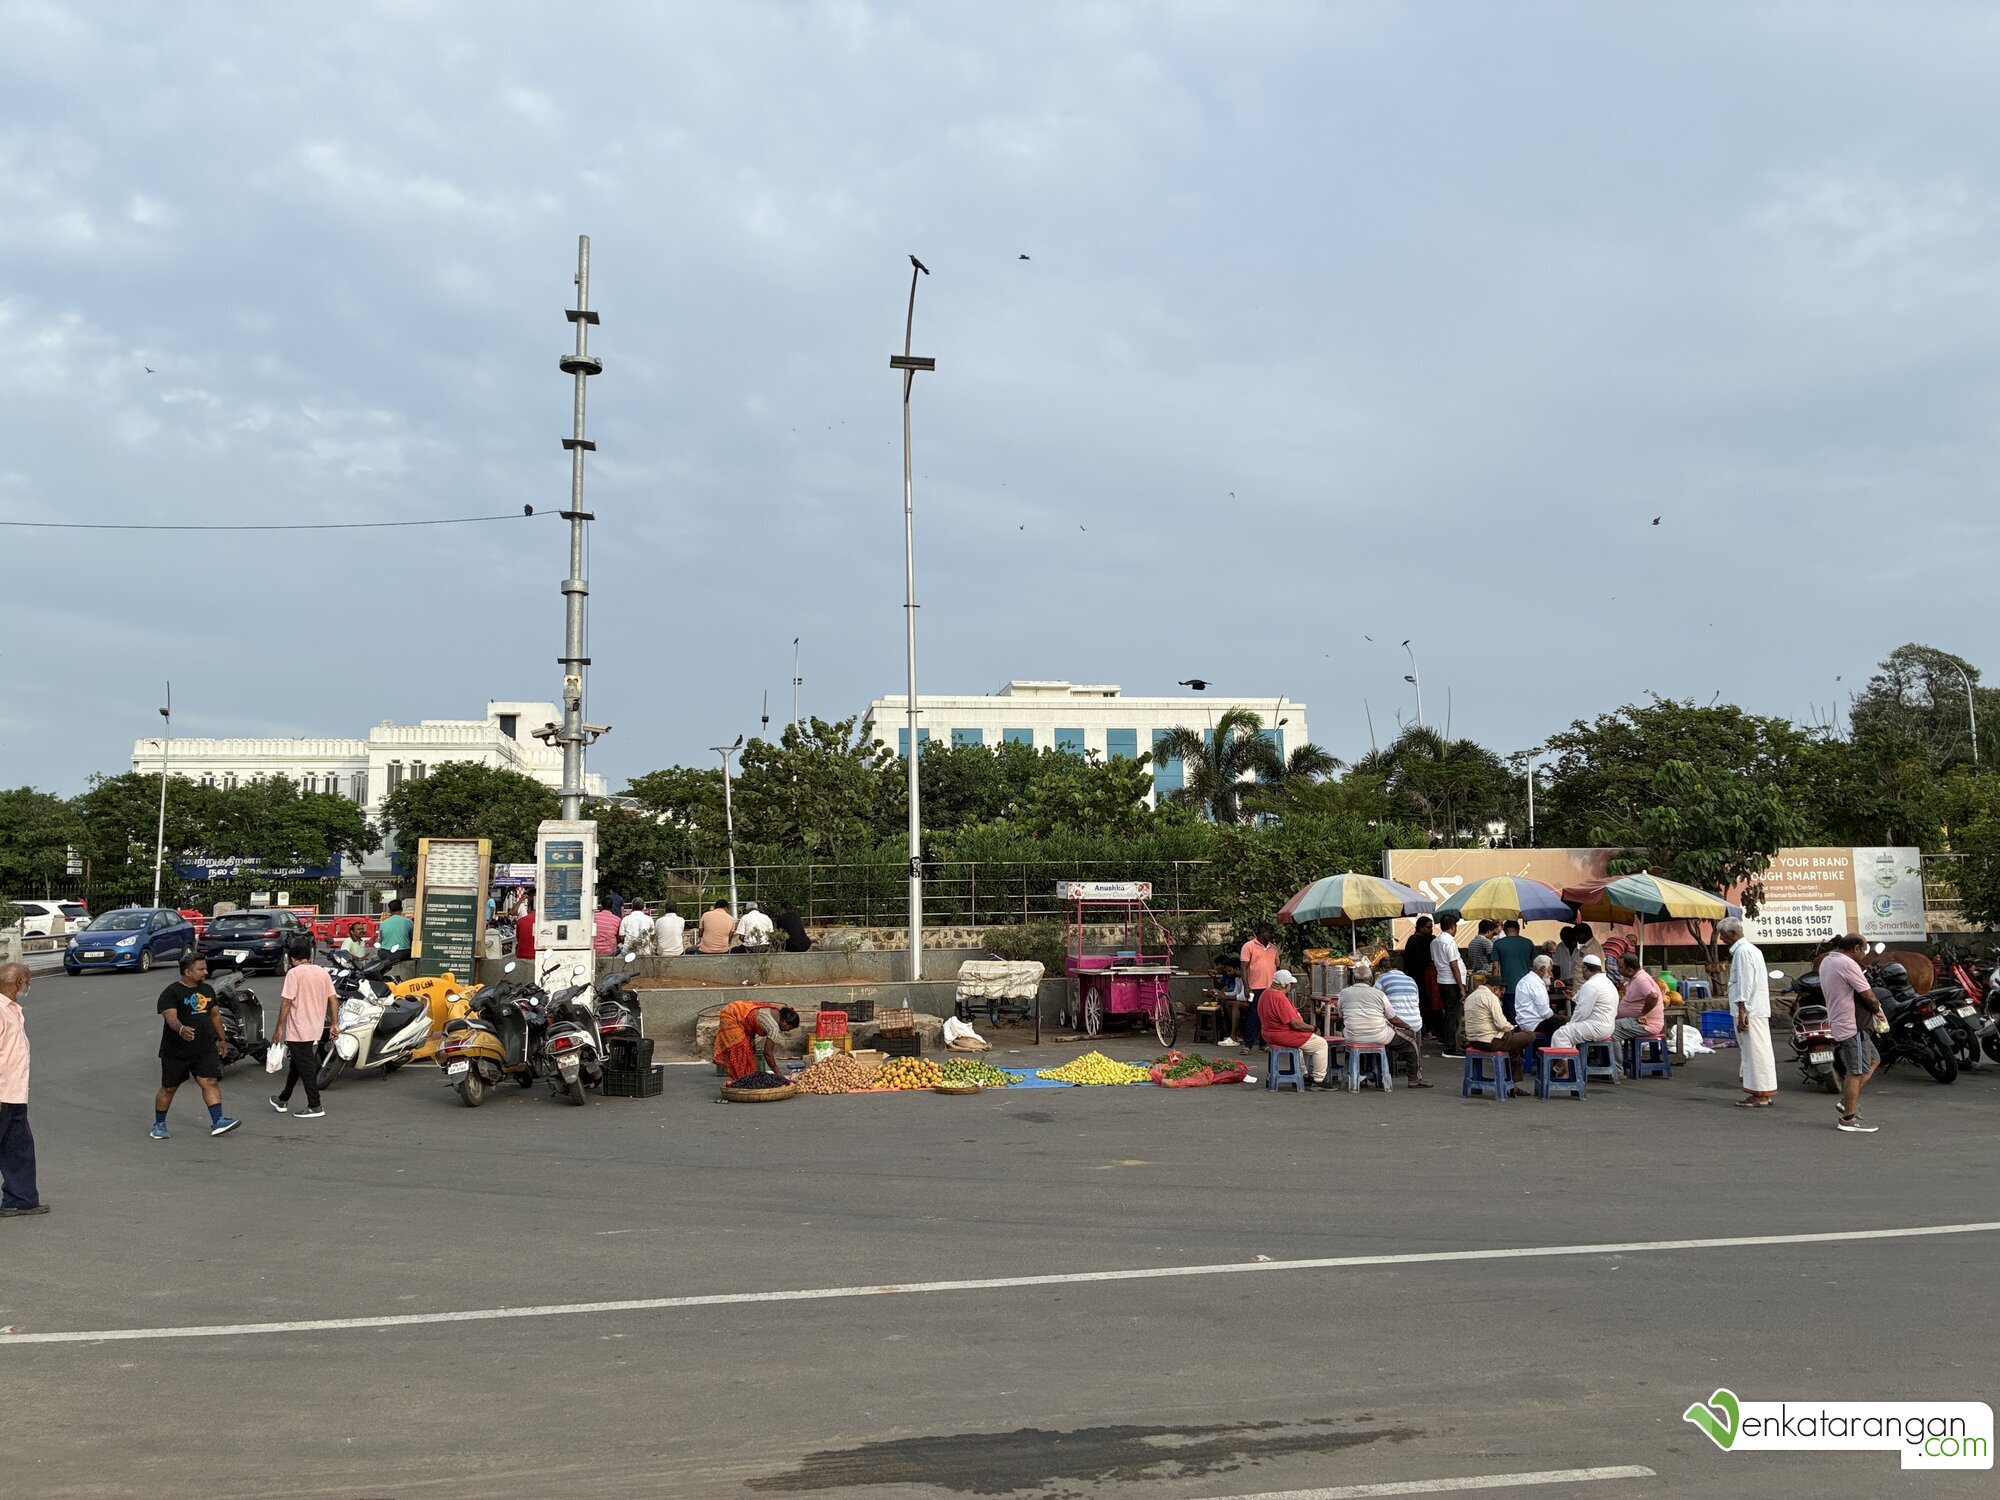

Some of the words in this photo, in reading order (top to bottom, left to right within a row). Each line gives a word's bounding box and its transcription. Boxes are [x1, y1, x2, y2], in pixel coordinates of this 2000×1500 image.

[1780, 858, 1809, 867] YOUR
[1812, 857, 1849, 867] BRAND
[1737, 870, 1783, 881] OUGH
[1787, 870, 1845, 881] SMARTBIKE
[1814, 904, 1834, 912] Space
[1756, 916, 1772, 925] +91
[1775, 916, 1803, 925] 81486
[1805, 915, 1832, 924] 15057
[1878, 921, 1920, 930] SmartBike
[1757, 928, 1773, 937] +91
[1776, 928, 1804, 937] 99626
[1806, 928, 1833, 937] 31048
